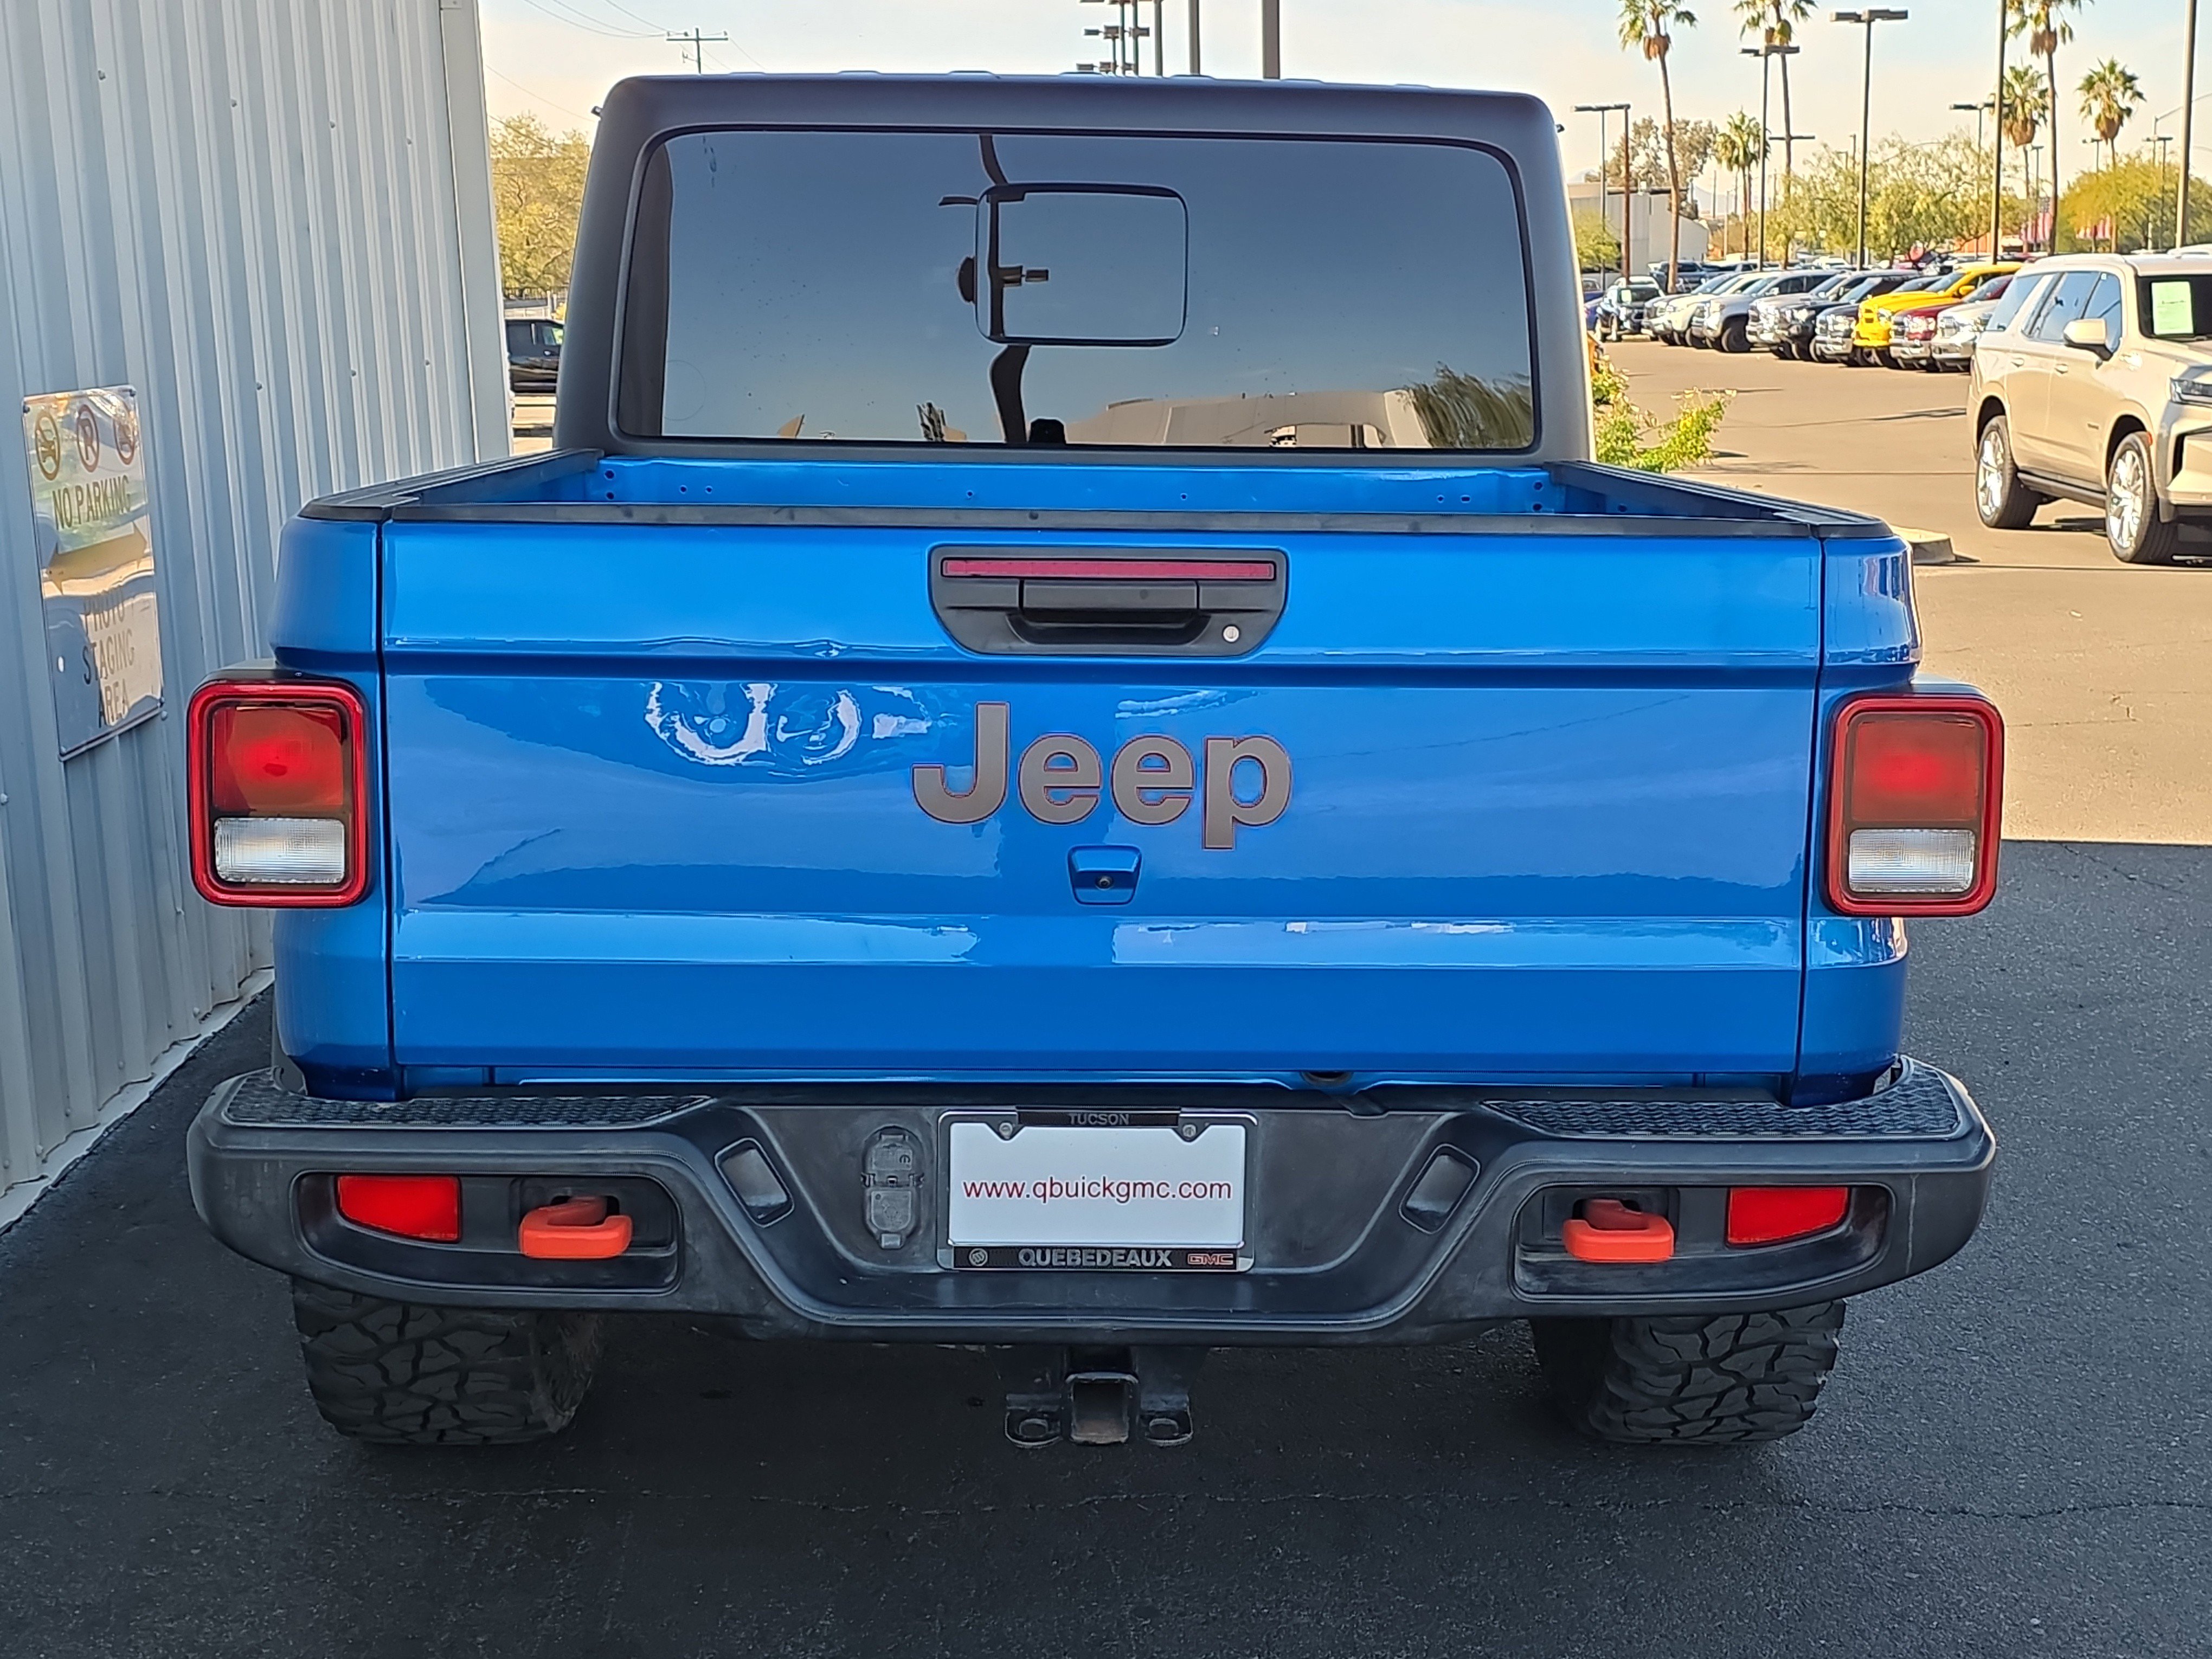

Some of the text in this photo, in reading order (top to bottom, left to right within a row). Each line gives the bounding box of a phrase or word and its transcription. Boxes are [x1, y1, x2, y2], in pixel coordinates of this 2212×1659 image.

[53, 475, 131, 530] NO PARKING
[82, 628, 134, 684] STAGING
[98, 679, 129, 728] AREA
[911, 701, 1293, 850] Jeep
[1068, 1113, 1130, 1126] TUCSON
[963, 1176, 1232, 1204] www.qbuickgmc.com
[1018, 1248, 1234, 1268] QUEBEDEAUX GMC
